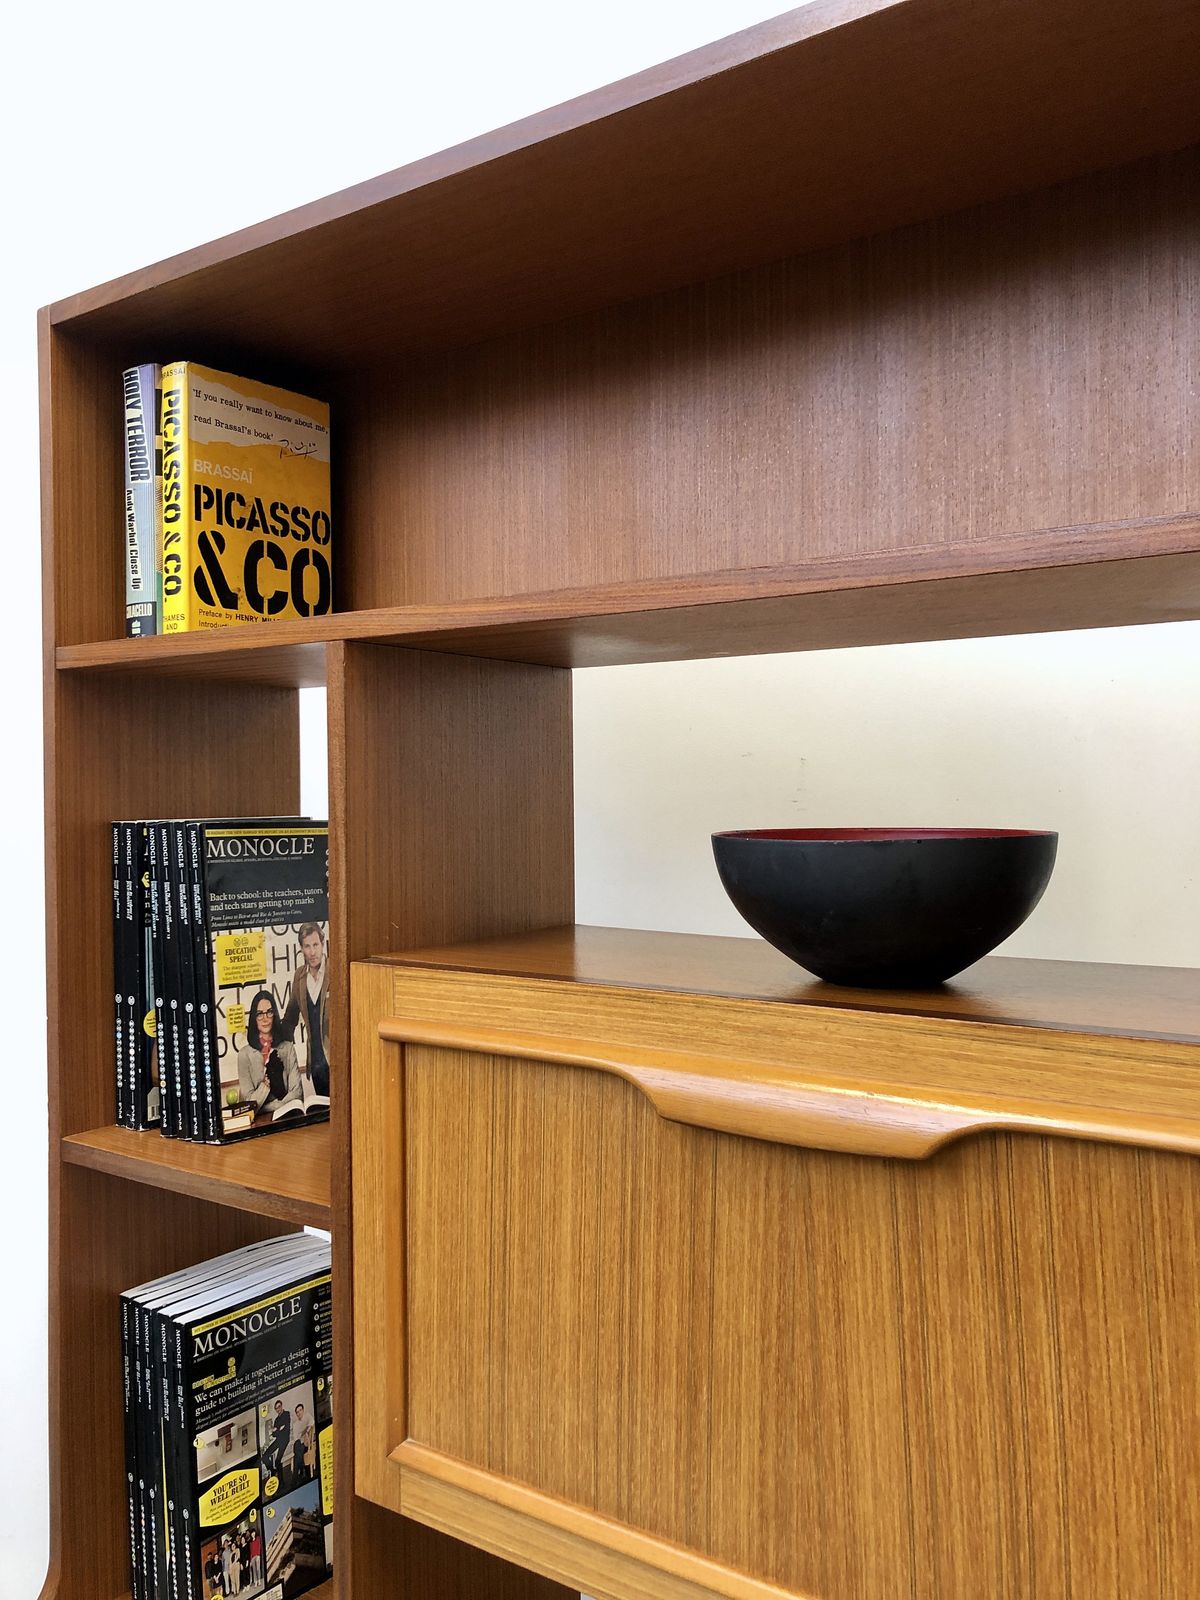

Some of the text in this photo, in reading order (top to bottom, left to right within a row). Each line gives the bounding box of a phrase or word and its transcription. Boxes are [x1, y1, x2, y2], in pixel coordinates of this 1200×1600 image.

[123, 369, 151, 482] HOLY TERROR
[193, 415, 212, 425] read
[203, 392, 218, 403] you
[220, 398, 243, 411] really
[245, 404, 263, 416] want
[265, 408, 273, 417] to
[274, 411, 292, 423] know
[294, 418, 313, 430] about
[315, 424, 329, 435] me,
[163, 388, 181, 524] PICASSO
[127, 513, 138, 547] Warhol
[194, 484, 331, 546] PICASSO
[129, 549, 139, 575] Close
[131, 578, 141, 590] Up
[199, 608, 223, 618] Preface
[225, 612, 233, 620] by
[235, 614, 259, 623] HENRY
[161, 828, 169, 866] MONOCLE
[176, 830, 185, 868] MONOCLE
[190, 830, 199, 869] MONOCLE
[206, 837, 315, 858] MONOCLE
[210, 887, 324, 902] Back to school: the teachers, tutors
[210, 896, 315, 911] and tech stars getting top marks
[225, 946, 257, 956] EDUCATION
[229, 954, 254, 963] SPECIAL
[193, 1296, 302, 1358] MONOCLE
[194, 1347, 310, 1404] We can make it together: a design
[195, 1358, 310, 1417] guide to building it better in 2015
[210, 1492, 231, 1506] WELL
[231, 1480, 251, 1496] BUILT
[212, 1473, 248, 1497] YOU'RE SO
